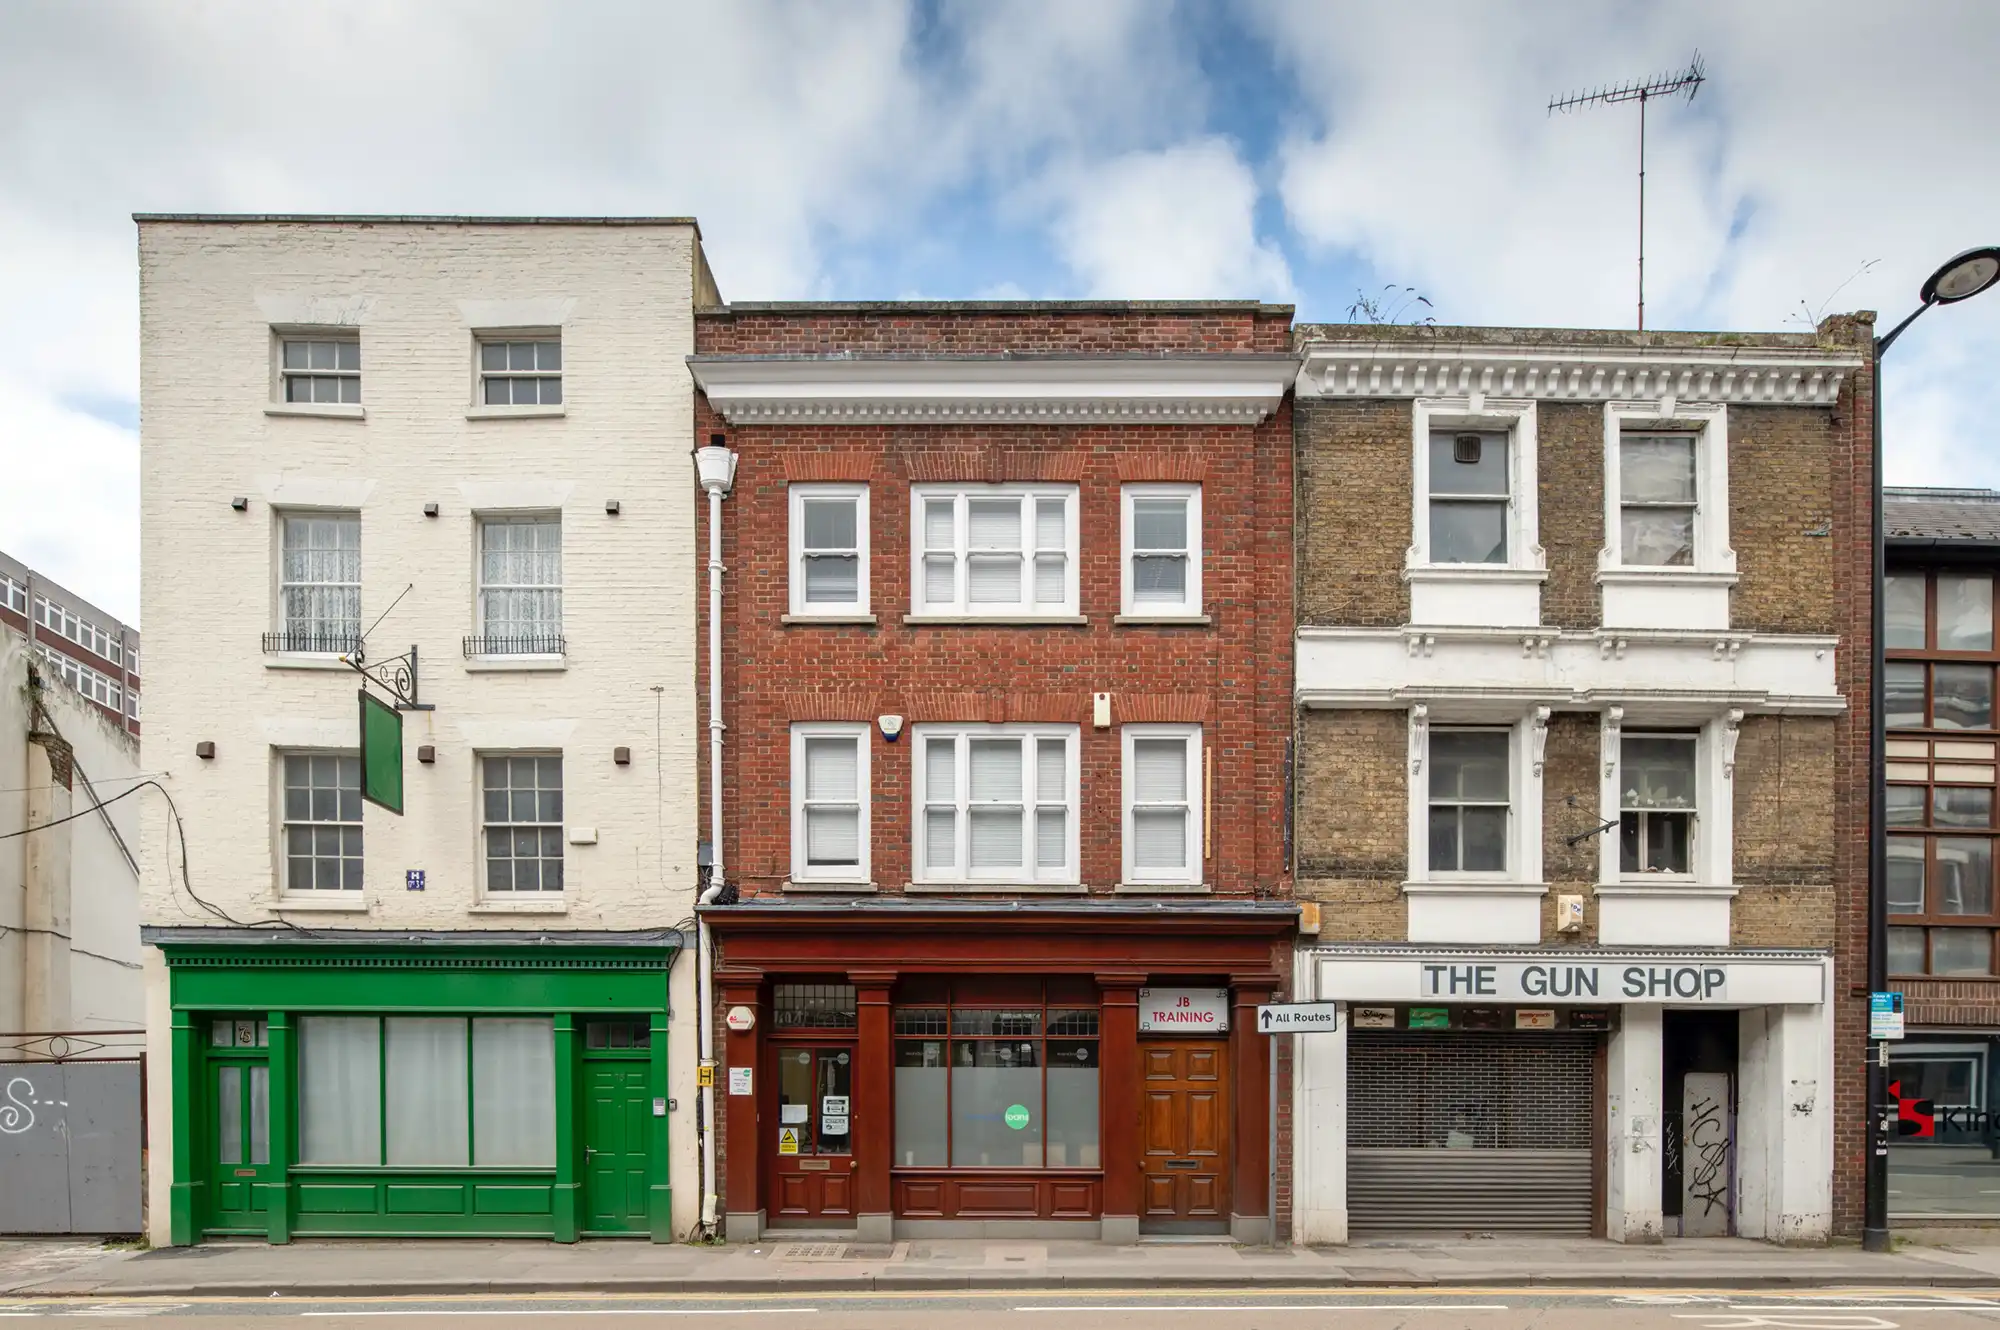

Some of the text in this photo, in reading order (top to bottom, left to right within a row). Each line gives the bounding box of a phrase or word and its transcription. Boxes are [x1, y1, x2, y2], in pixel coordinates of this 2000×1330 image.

[411, 871, 420, 880] H
[1424, 965, 1726, 998] THE GUN SHOP
[1176, 996, 1190, 1008] JB
[1152, 1011, 1214, 1023] TRAINING
[1275, 1012, 1331, 1023] All Routes
[239, 1026, 251, 1043] 75
[700, 1069, 711, 1084] H
